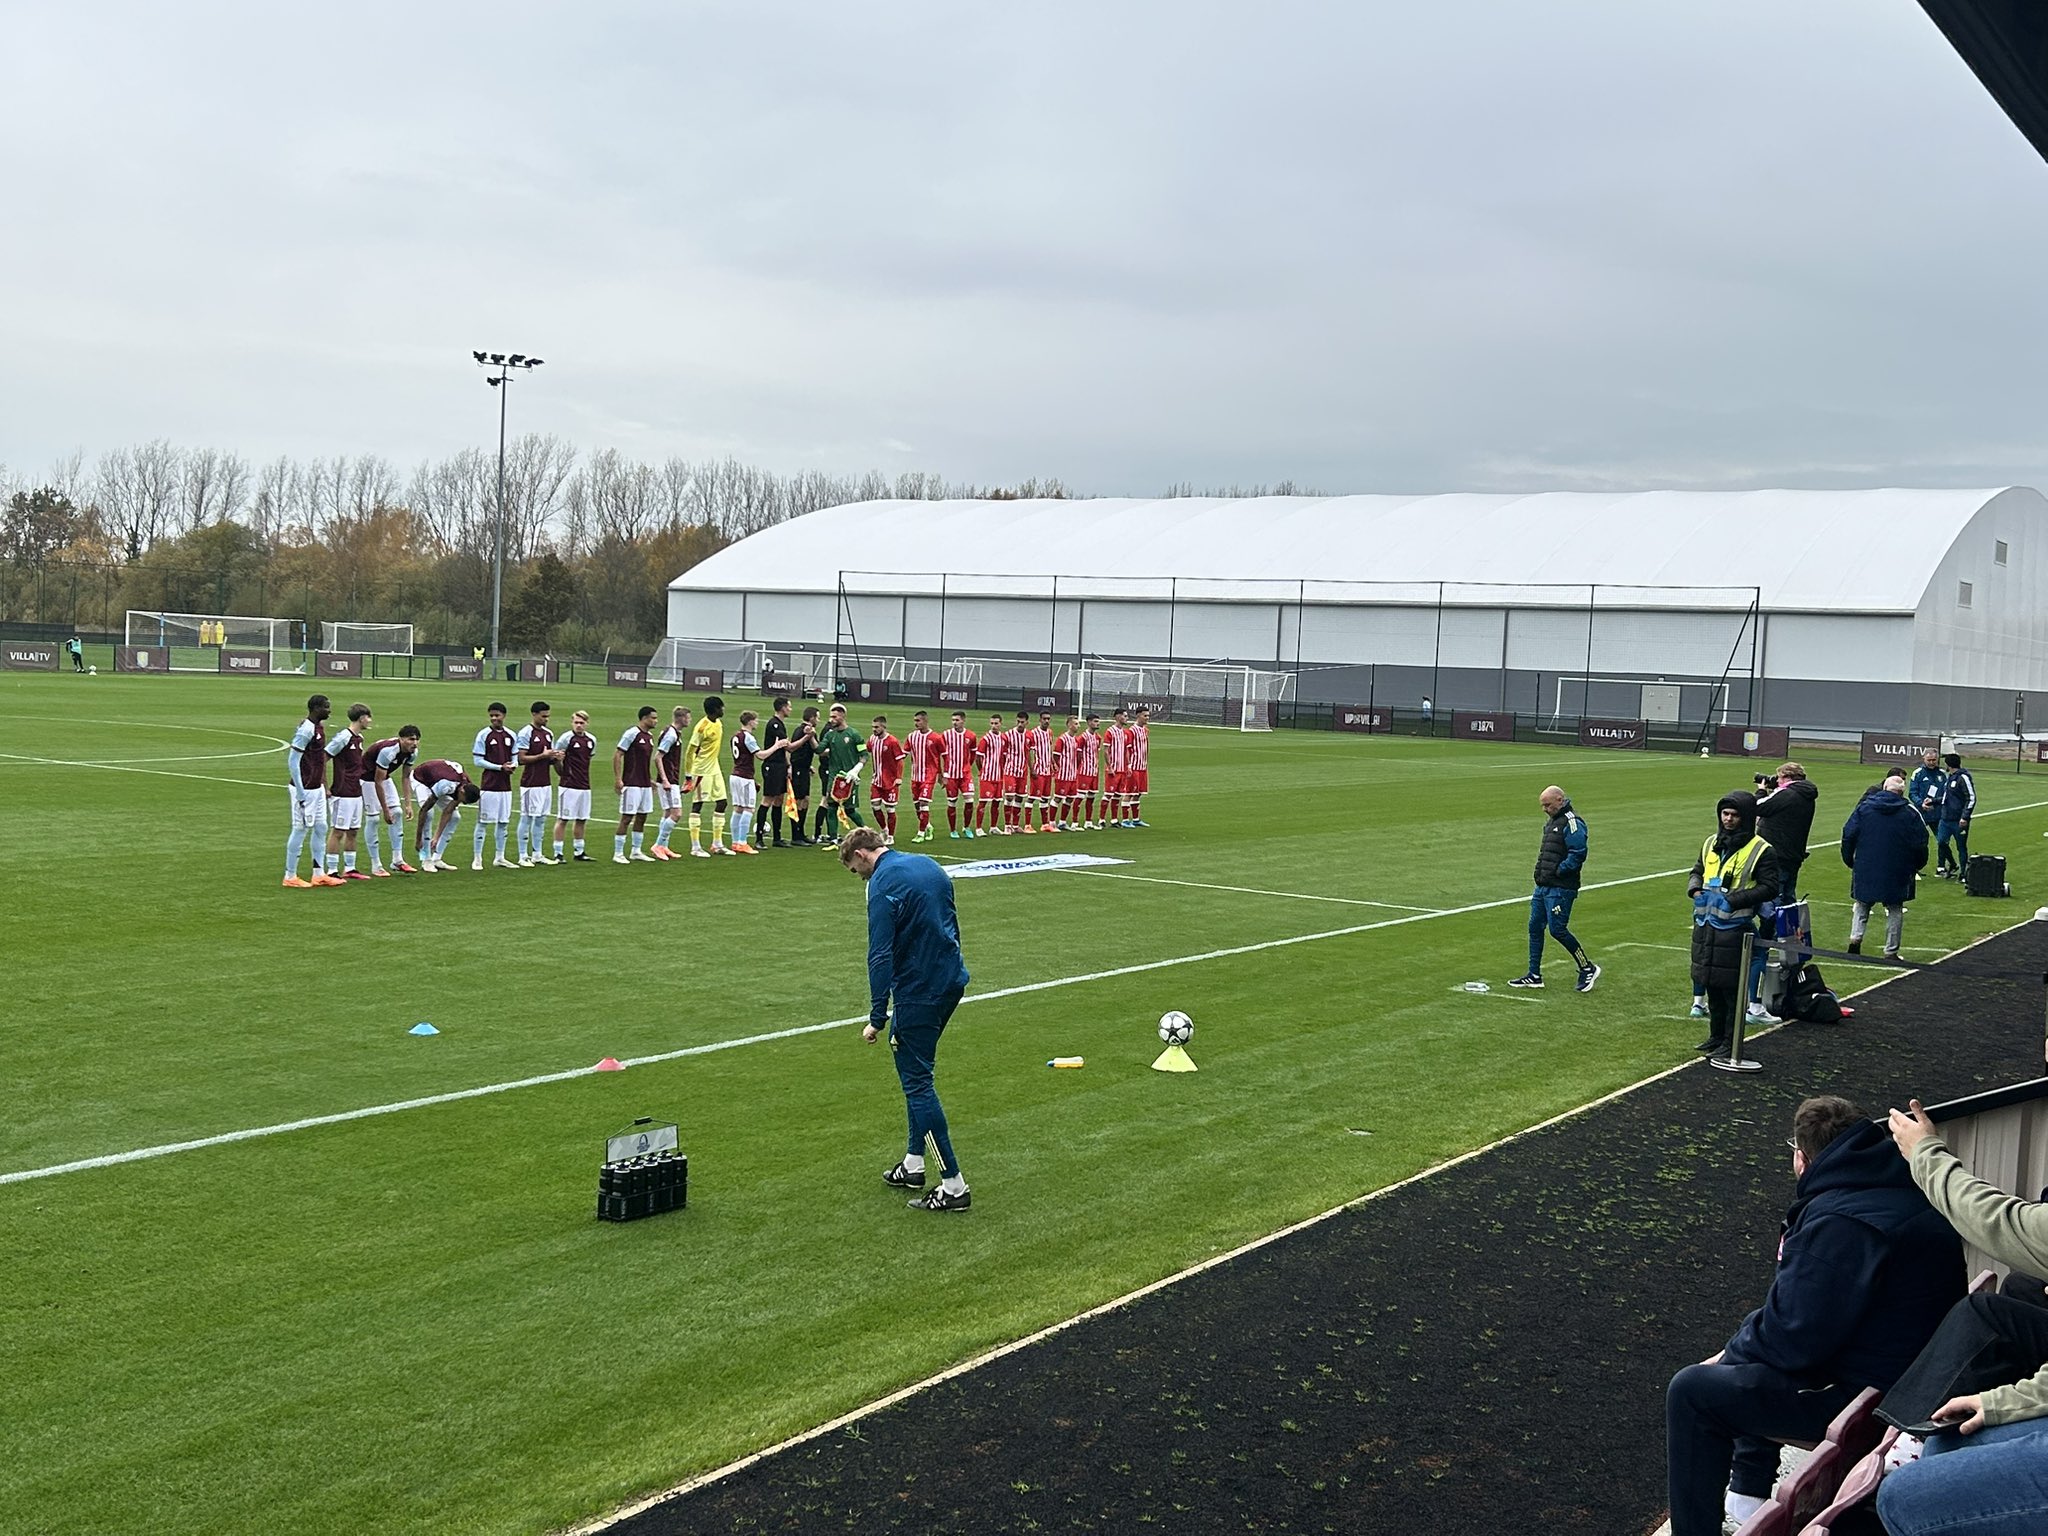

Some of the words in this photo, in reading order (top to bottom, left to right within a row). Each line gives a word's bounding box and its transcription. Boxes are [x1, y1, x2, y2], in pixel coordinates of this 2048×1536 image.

[9, 651, 35, 661] VILLA
[38, 652, 51, 661] TV
[448, 665, 467, 673] VILLA
[469, 665, 478, 673] TV
[767, 681, 786, 690] VILLA
[788, 682, 797, 690] TV
[1153, 703, 1163, 711] TV
[1477, 720, 1494, 732] 1874
[1589, 728, 1618, 738] VILLA
[1622, 730, 1636, 739] TV
[731, 735, 740, 759] 6
[1873, 743, 1906, 755] VILLA
[1911, 746, 1927, 756] TV
[922, 788, 929, 797] 5
